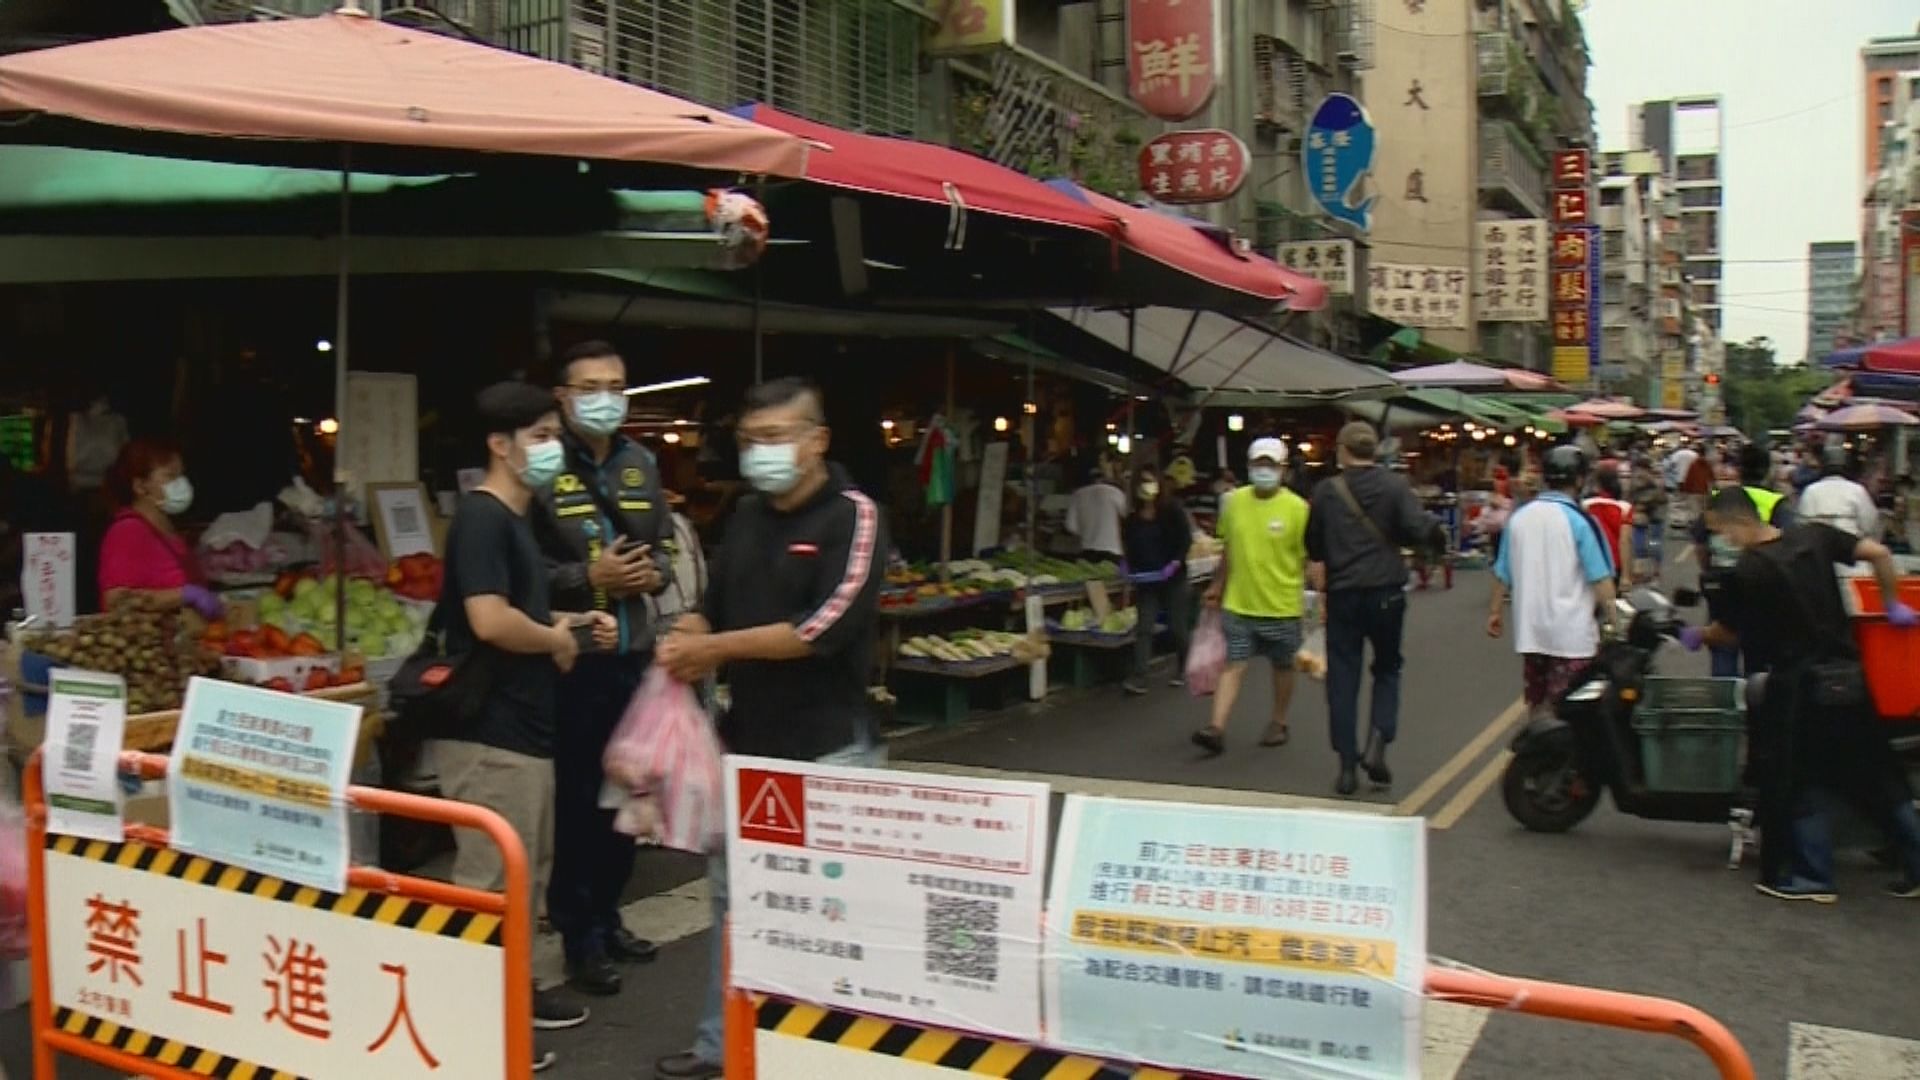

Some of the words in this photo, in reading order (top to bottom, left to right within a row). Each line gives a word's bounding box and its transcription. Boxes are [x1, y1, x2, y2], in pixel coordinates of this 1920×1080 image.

[1150, 166, 1233, 193] 生魚片
[85, 893, 440, 1070] 禁止進入
